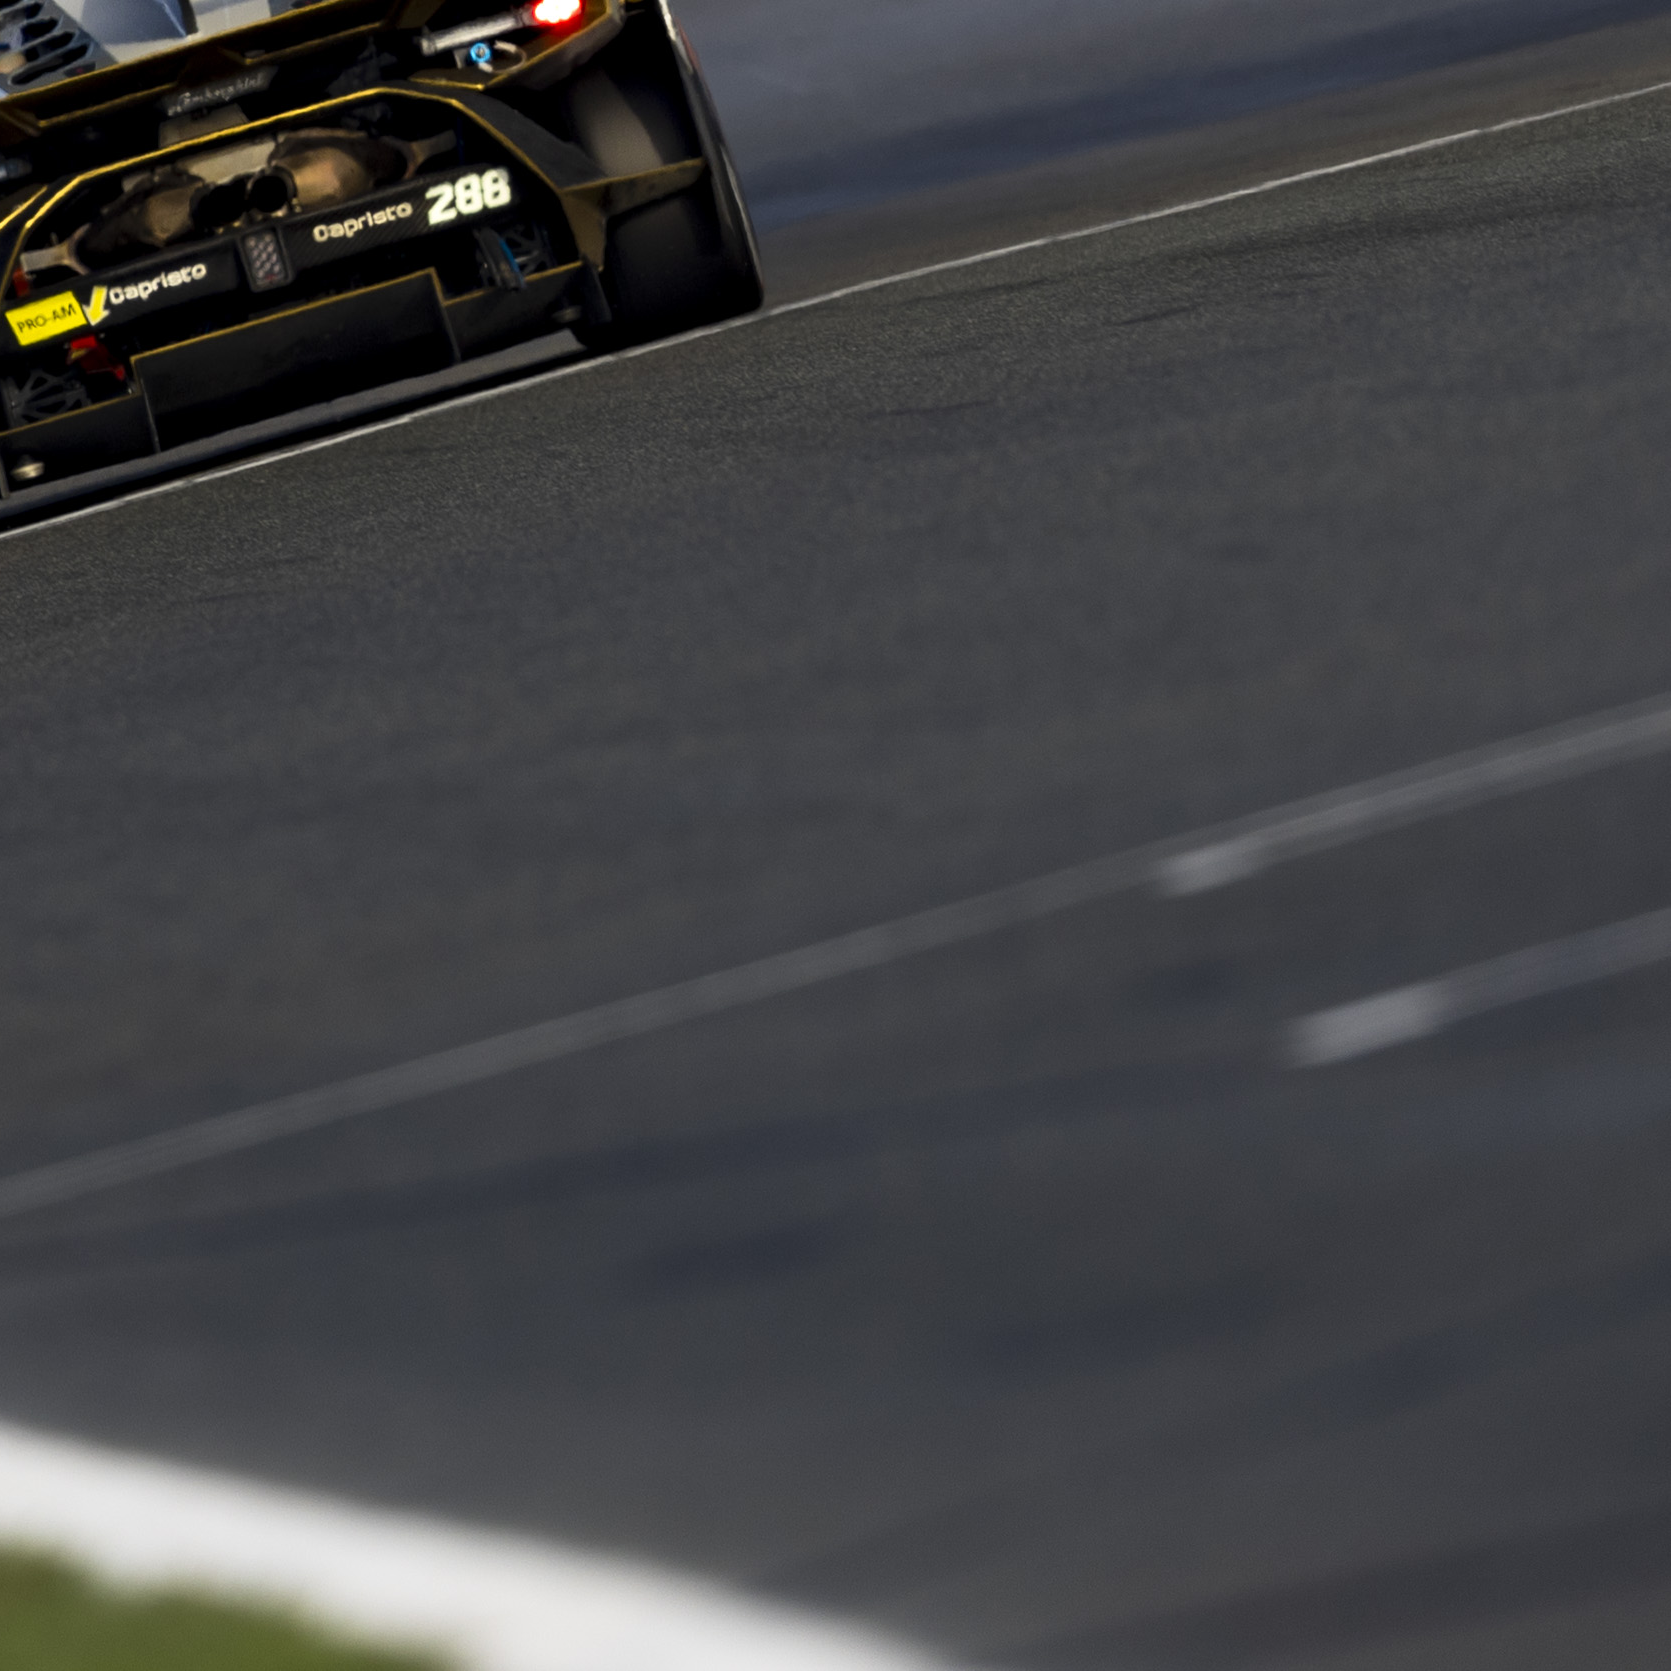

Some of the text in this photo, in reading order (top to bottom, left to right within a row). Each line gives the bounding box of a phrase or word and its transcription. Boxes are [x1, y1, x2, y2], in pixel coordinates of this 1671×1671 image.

[424, 168, 511, 226] 288
[313, 201, 414, 242] Capristo
[108, 263, 207, 305] Capristo
[16, 302, 77, 334] PRO-AM
